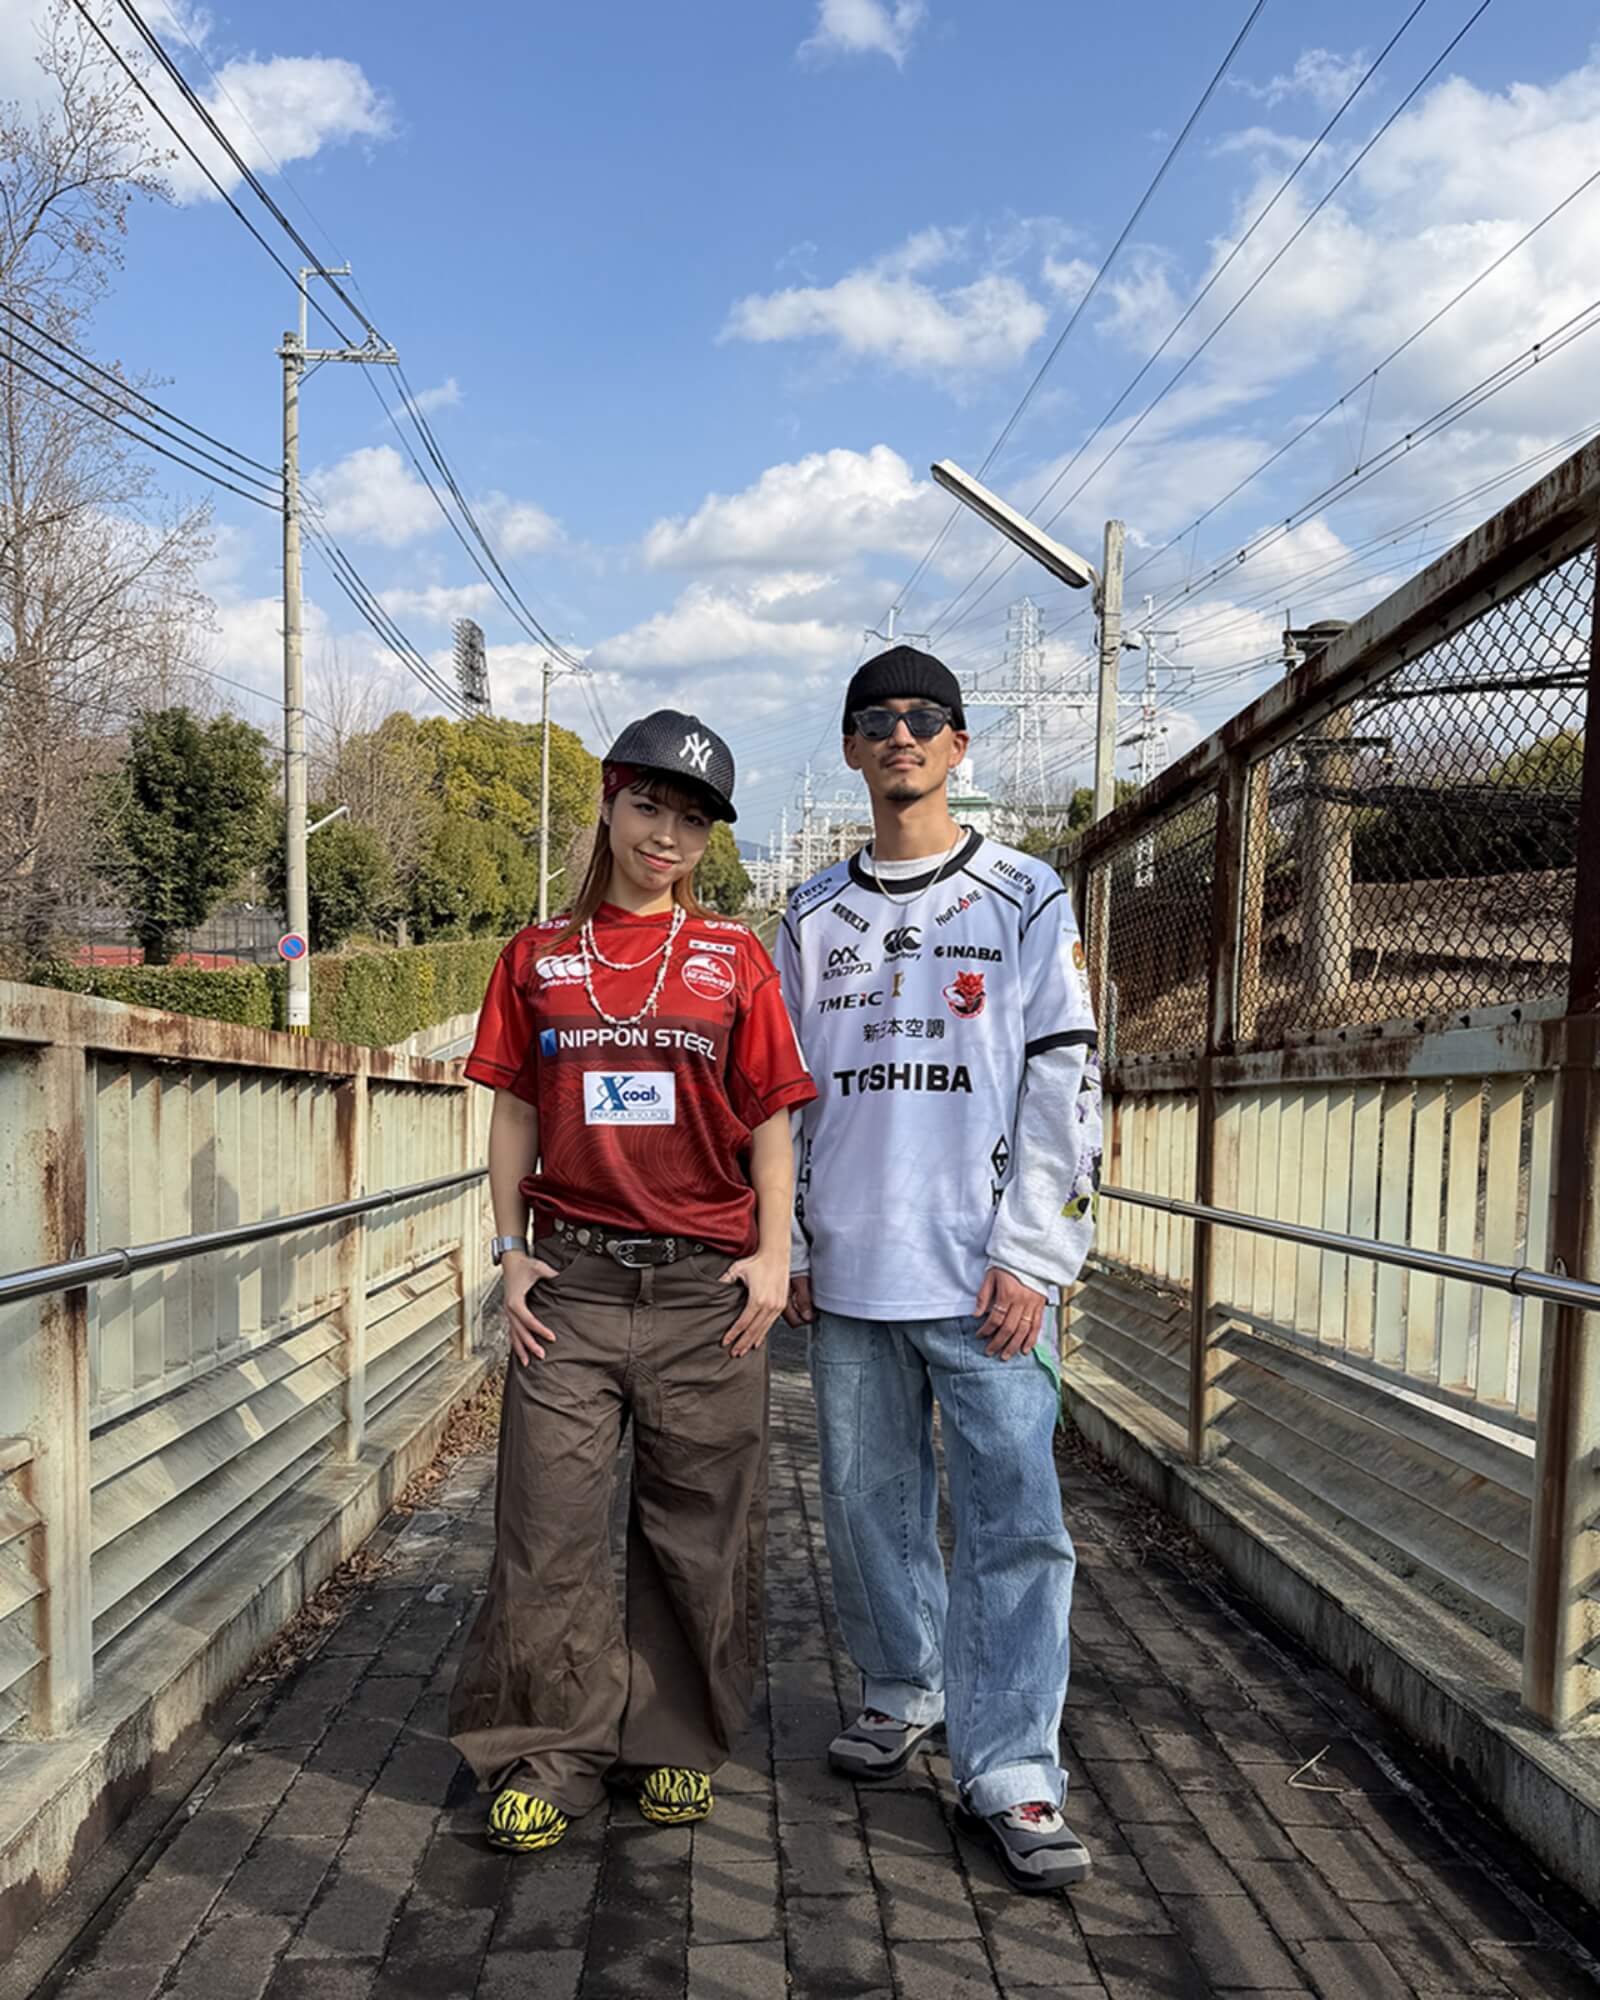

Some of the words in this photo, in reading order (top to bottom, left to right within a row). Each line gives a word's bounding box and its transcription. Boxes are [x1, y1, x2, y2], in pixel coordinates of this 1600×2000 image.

[680, 732, 713, 772] NY
[993, 860, 1036, 895] Niterra
[947, 946, 1002, 962] INABA
[559, 1029, 648, 1048] NIPPON
[655, 1029, 717, 1061] STEEL
